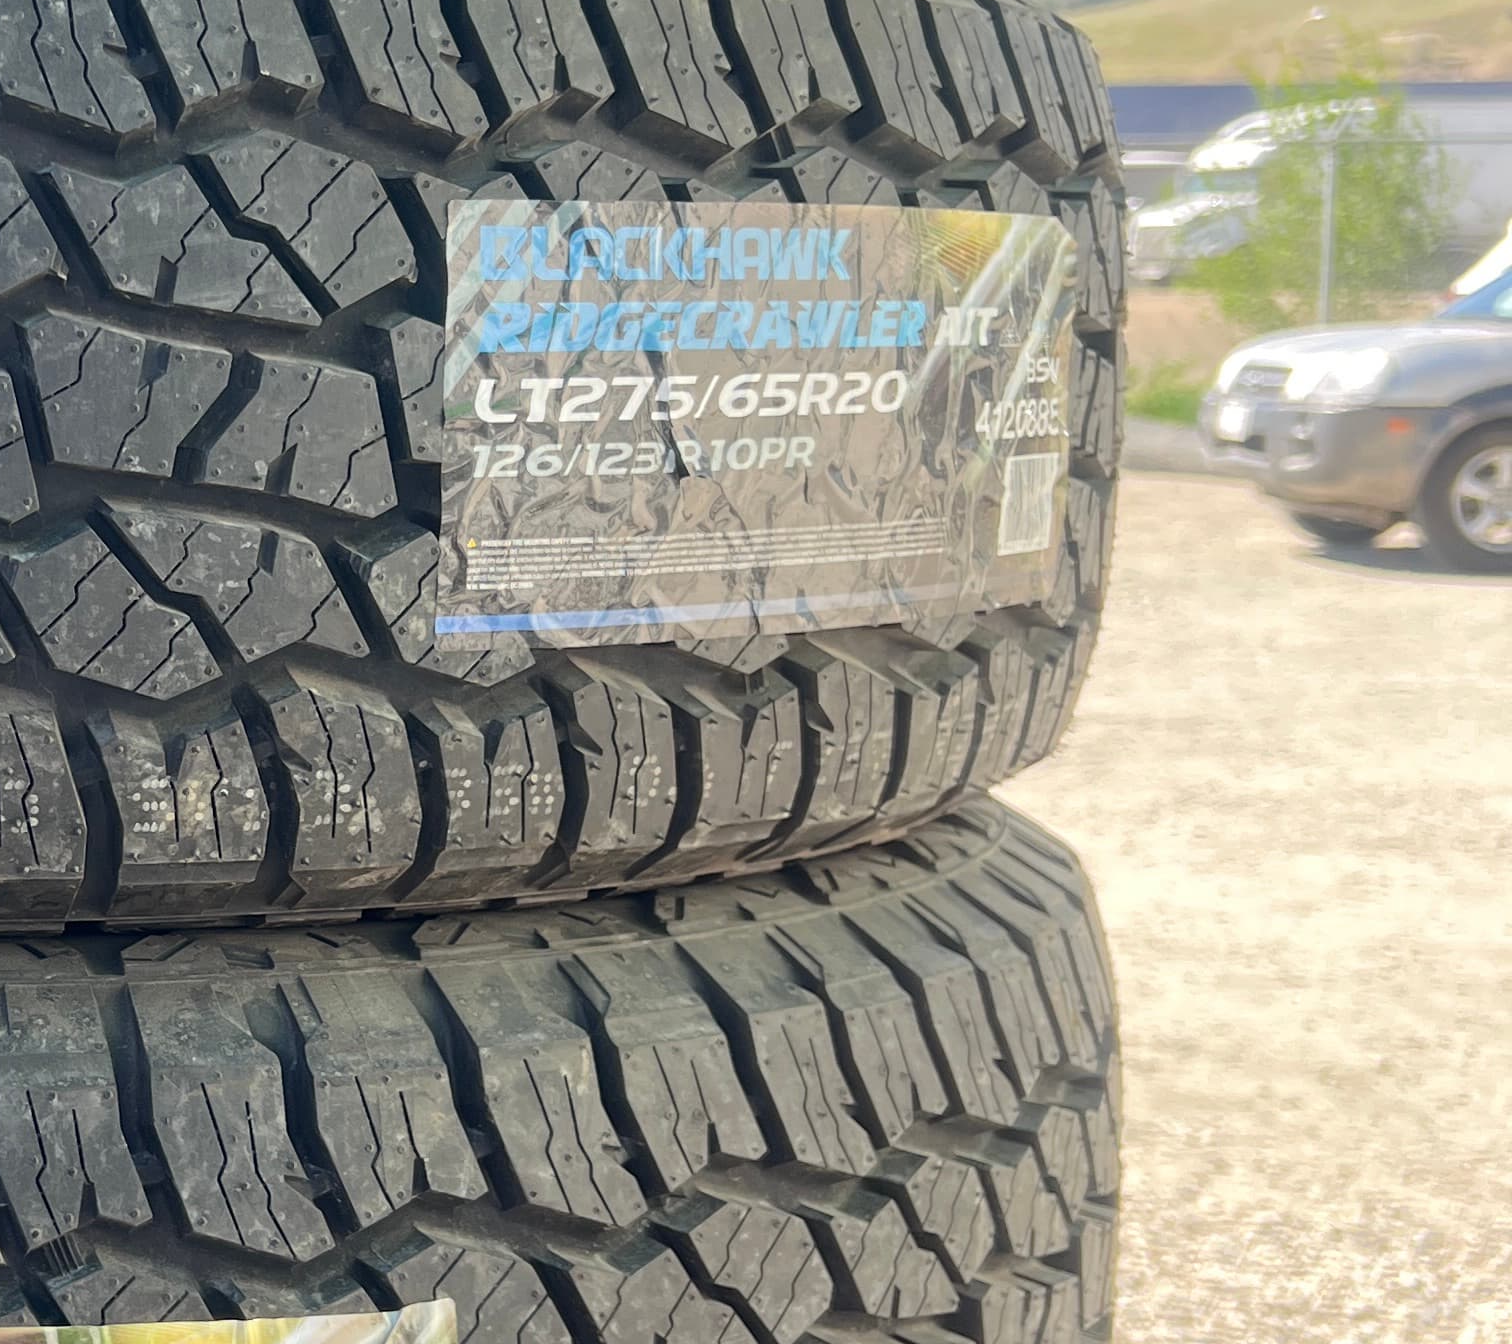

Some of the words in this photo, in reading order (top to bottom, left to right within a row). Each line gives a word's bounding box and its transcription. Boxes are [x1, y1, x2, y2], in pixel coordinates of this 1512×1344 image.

[480, 224, 852, 281] BLACKHAWK
[473, 370, 908, 424] LT275/65R20
[472, 439, 702, 479] 126/123R
[709, 436, 814, 471] 10PR
